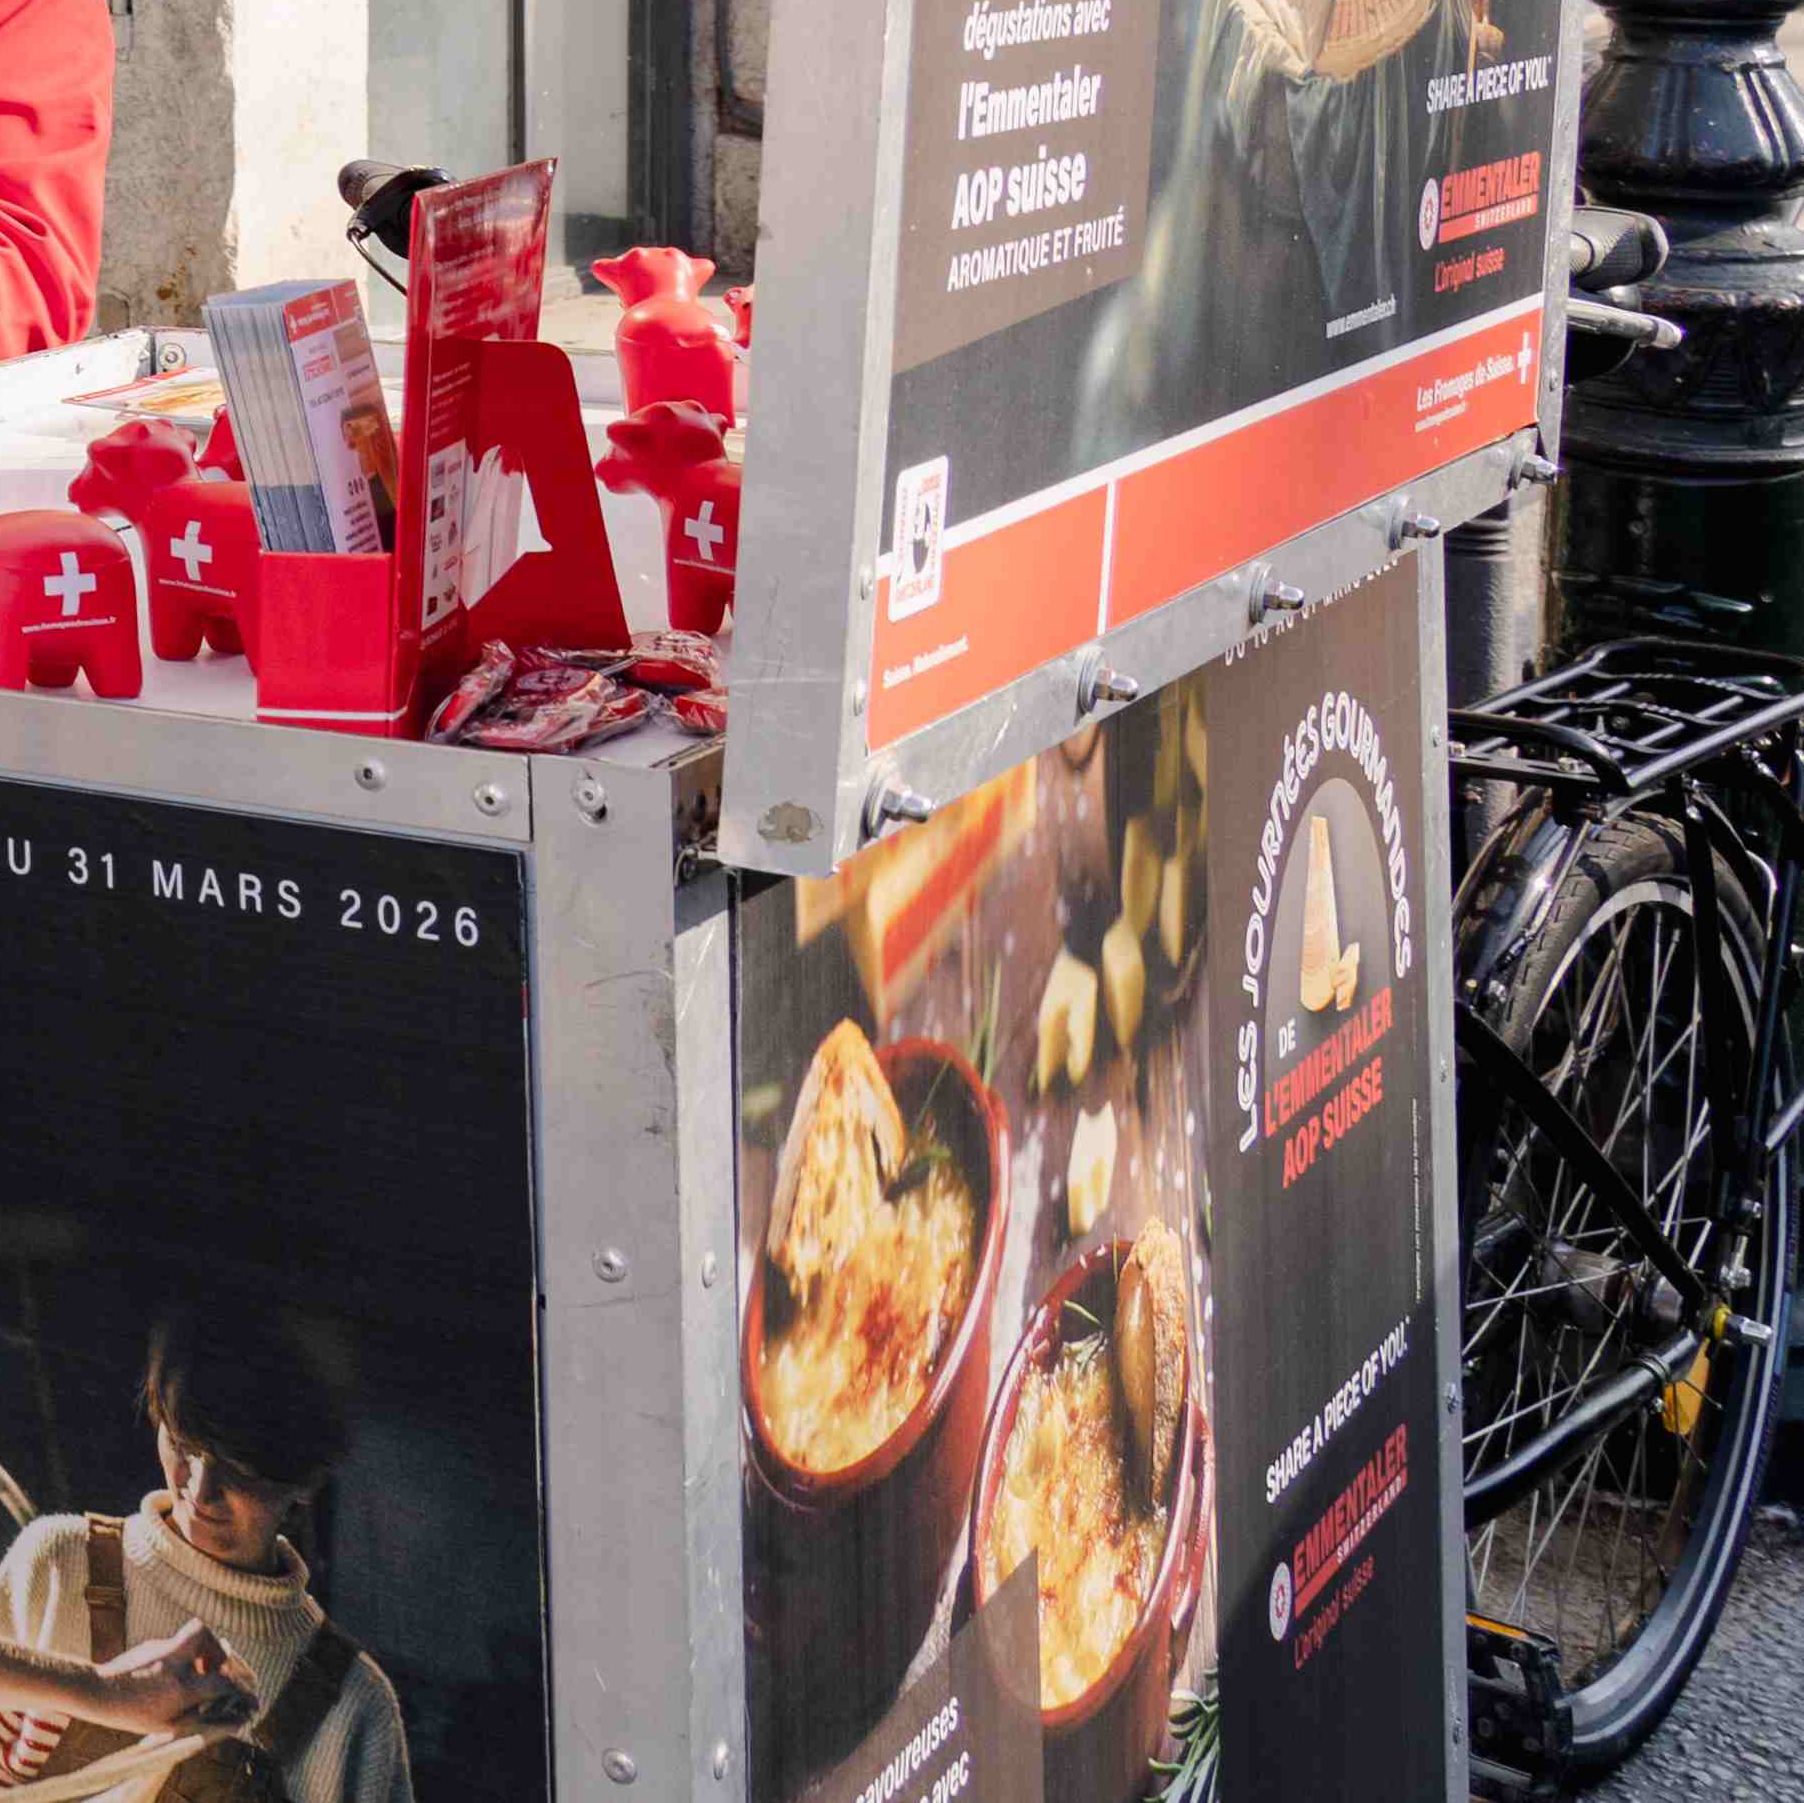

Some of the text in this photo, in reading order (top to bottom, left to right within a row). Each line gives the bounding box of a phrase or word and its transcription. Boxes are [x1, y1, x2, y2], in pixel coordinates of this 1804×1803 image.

[957, 62, 1103, 142] l'Emmentaler
[1425, 74, 1466, 115] SHARE
[1465, 71, 1476, 105] A
[1475, 64, 1509, 104] PIECE
[1508, 60, 1525, 96] OF
[950, 144, 1087, 231] AOP suisse
[1440, 150, 1542, 221] EMMENTALER
[946, 204, 1127, 294] AROMATIQUE ET FRUITÉ
[1475, 245, 1506, 279] suisse
[1416, 386, 1433, 413] Les
[1241, 703, 1320, 1010] JOURNÉES
[1320, 690, 1414, 980] GOURMANDES
[67, 846, 116, 889] 31
[151, 858, 303, 920] MARS
[338, 887, 481, 949] 2026
[1264, 986, 1394, 1140] L'EMMENTALER
[1277, 1017, 1297, 1060] DE
[1237, 1017, 1260, 1154] LES
[1281, 1055, 1384, 1190] AOP SUISSE
[1265, 1424, 1312, 1505] SHARE
[1312, 1414, 1324, 1450] A
[1324, 1371, 1362, 1444] PIECE
[1360, 1348, 1380, 1397] OF
[1293, 1421, 1408, 1592] EMMENTALER
[1335, 1475, 1403, 1566] SWITZERLAND
[1341, 1554, 1376, 1613] suisse
[931, 1750, 970, 1798] avec
